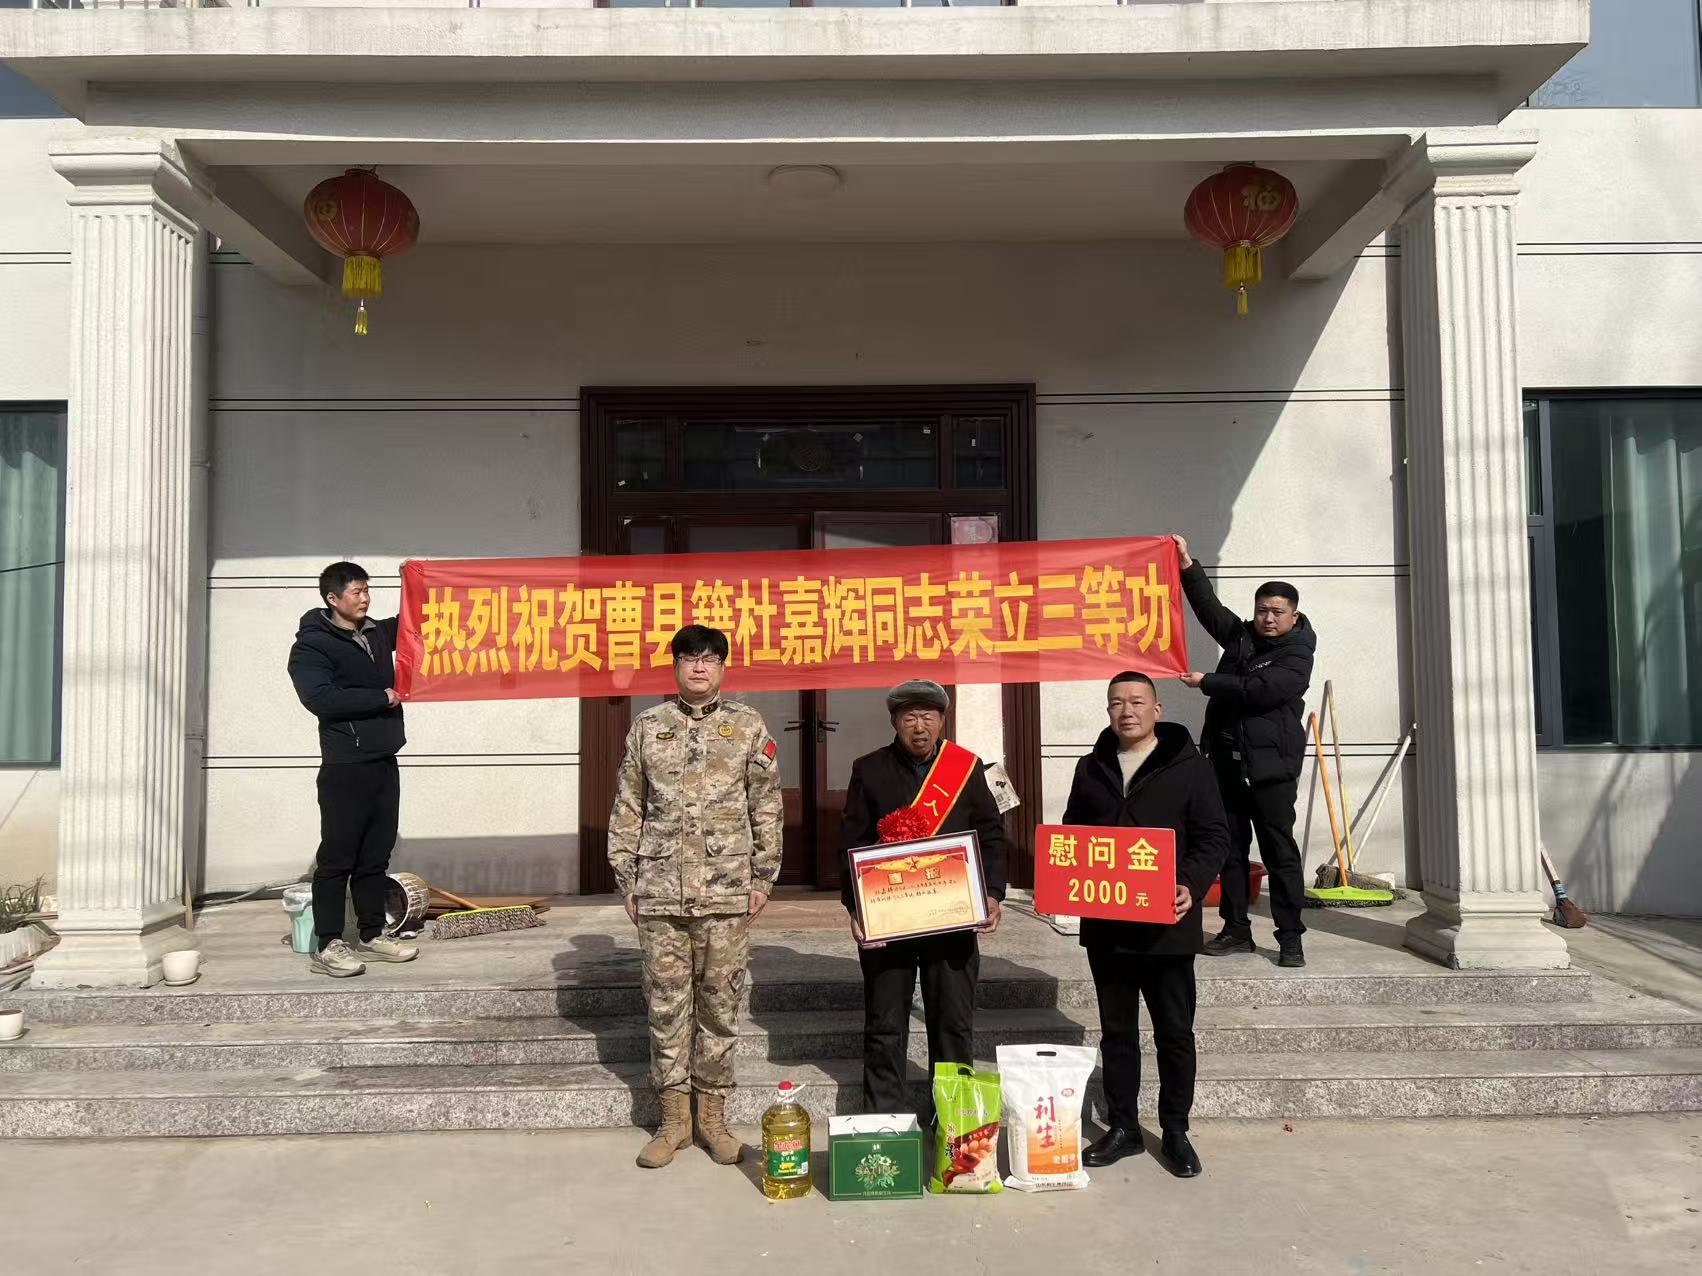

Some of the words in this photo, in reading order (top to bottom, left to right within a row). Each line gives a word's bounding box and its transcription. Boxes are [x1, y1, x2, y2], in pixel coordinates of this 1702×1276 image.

[419, 562, 1172, 678] 热烈祝贺曹县籍杜嘉辉同志荣立三等功
[1049, 833, 1159, 872] 慰问金
[1068, 878, 1127, 905] 2000
[1135, 892, 1149, 907] 元
[1034, 1096, 1056, 1149] 利生
